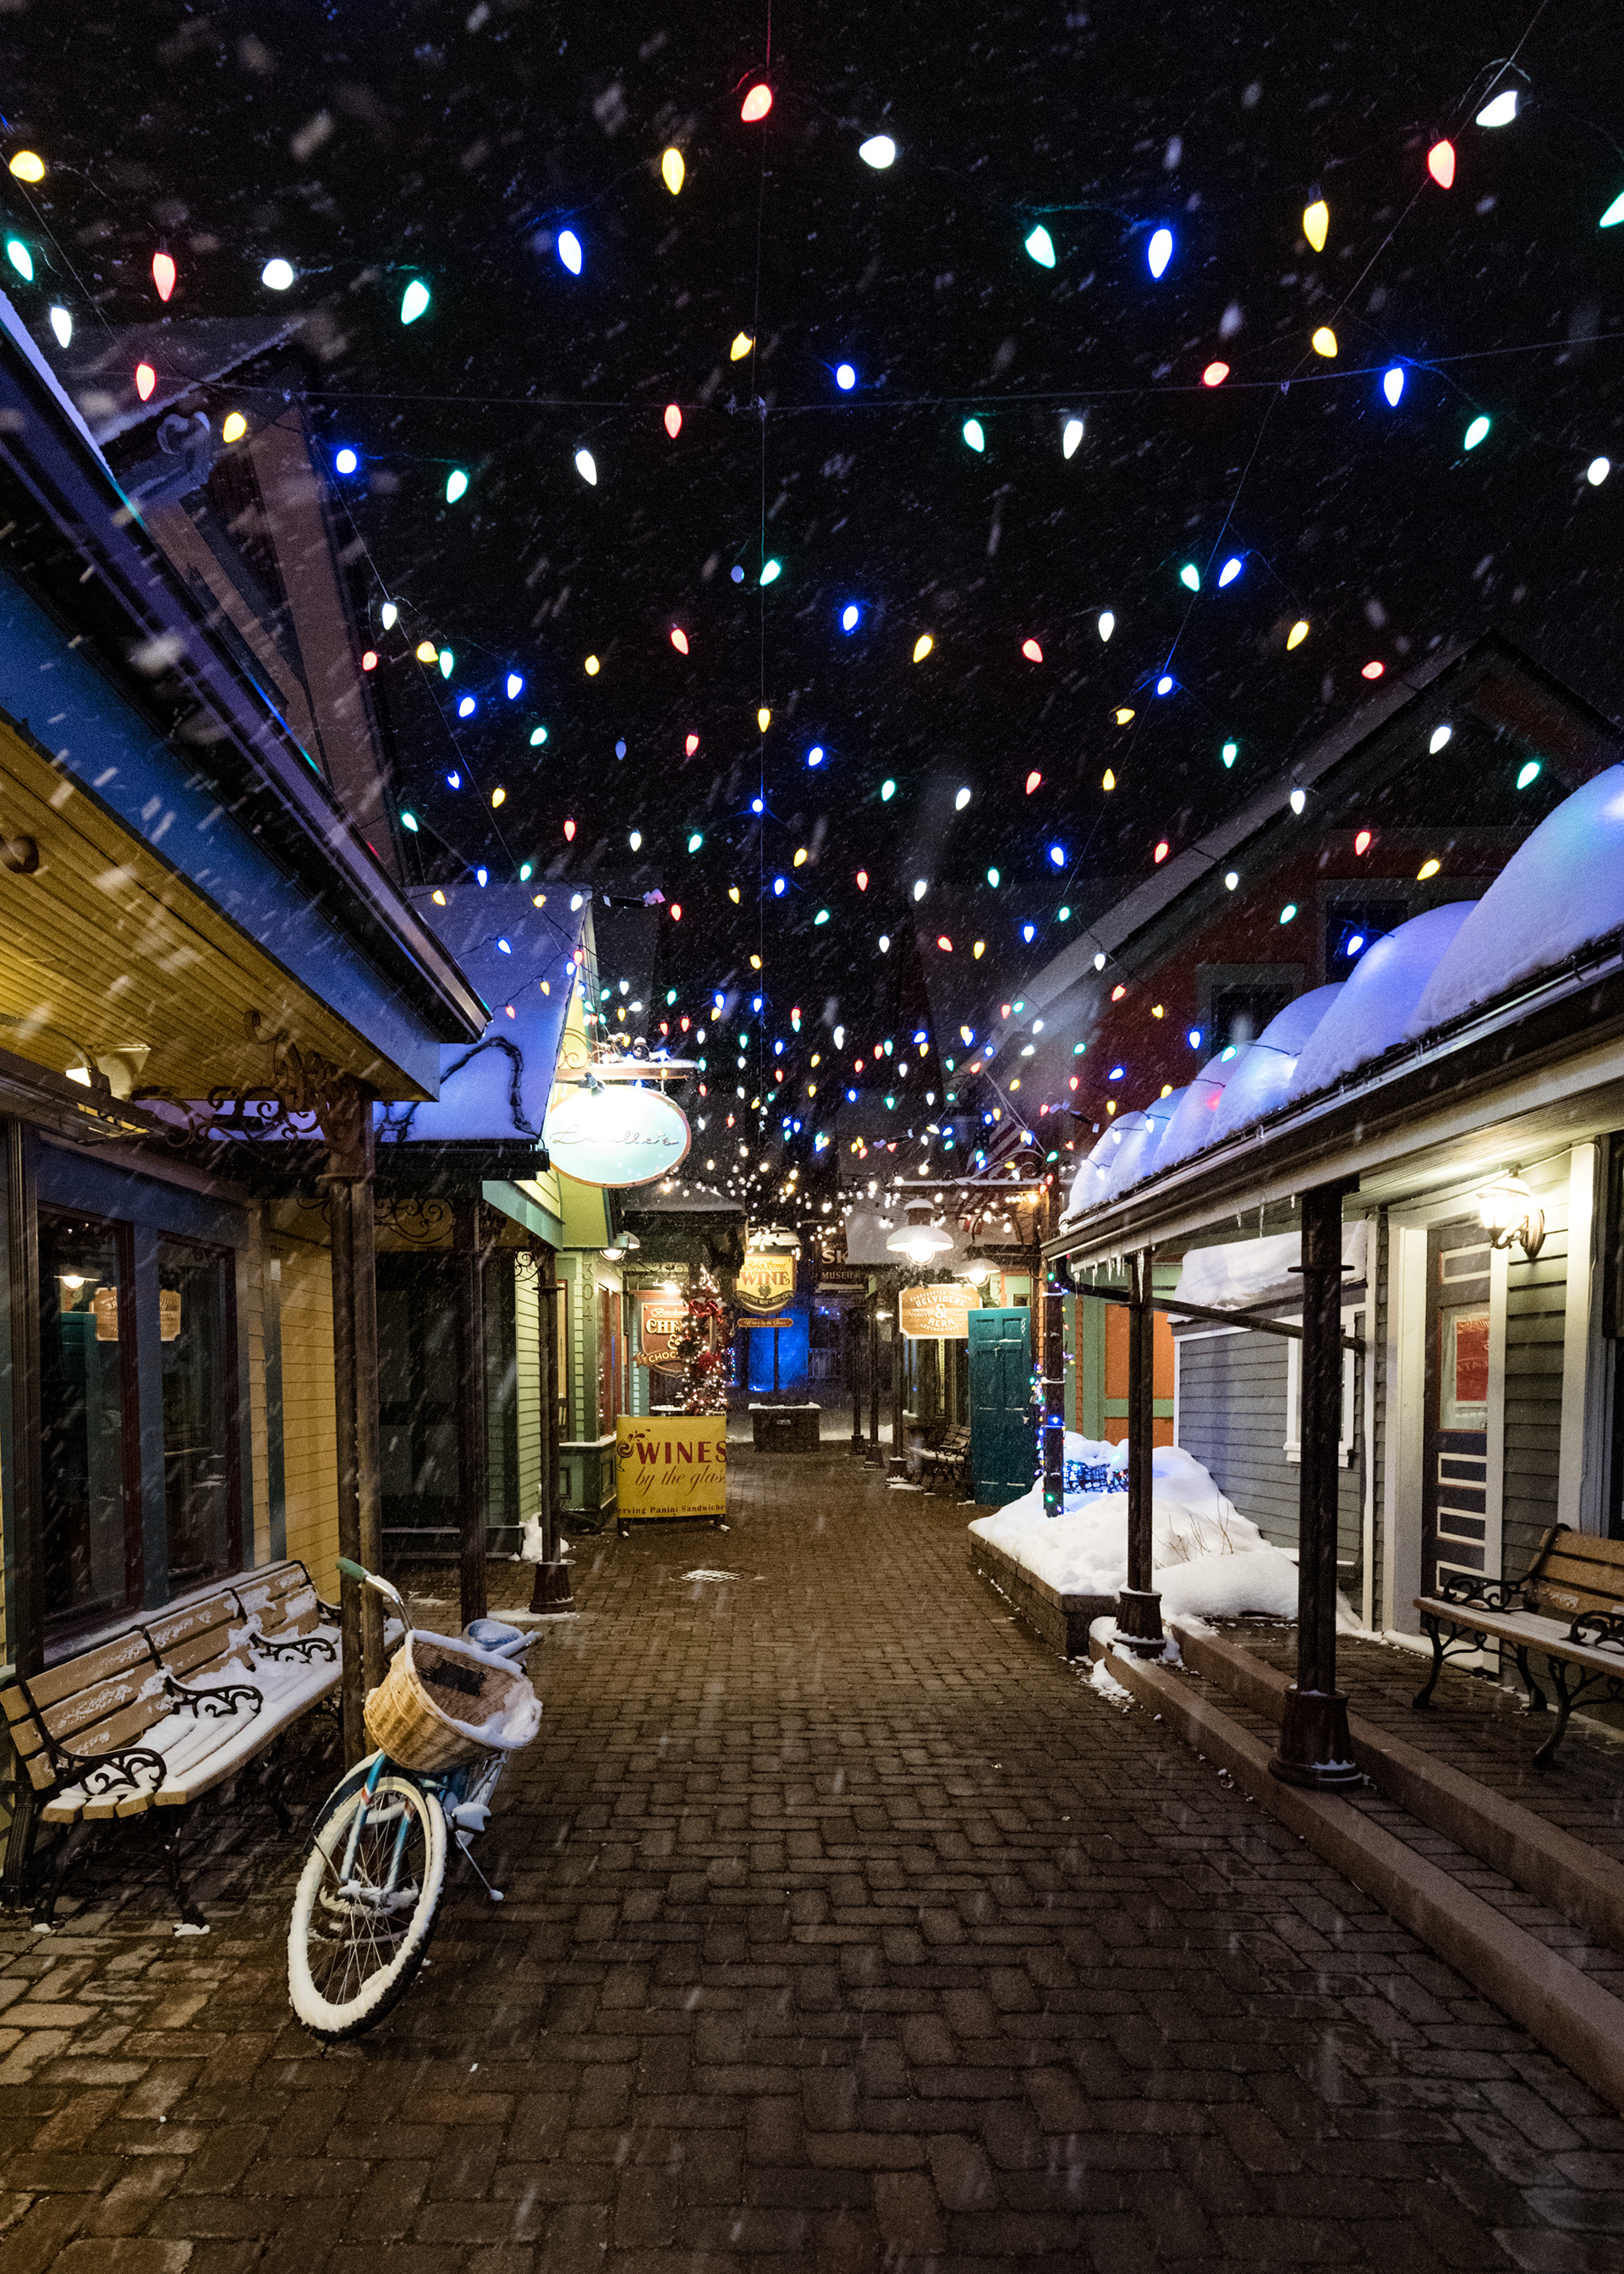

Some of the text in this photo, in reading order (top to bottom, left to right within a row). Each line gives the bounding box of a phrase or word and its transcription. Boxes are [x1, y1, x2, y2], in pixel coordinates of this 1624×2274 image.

[822, 1250, 848, 1264] SK
[740, 1271, 791, 1285] WINE
[915, 1294, 967, 1308] BELVIDERE
[934, 1303, 947, 1318] &
[636, 1441, 727, 1465] WINES
[634, 1466, 656, 1497] by
[661, 1465, 685, 1486] the
[616, 1504, 726, 1514] erving Panini Sandwiche
